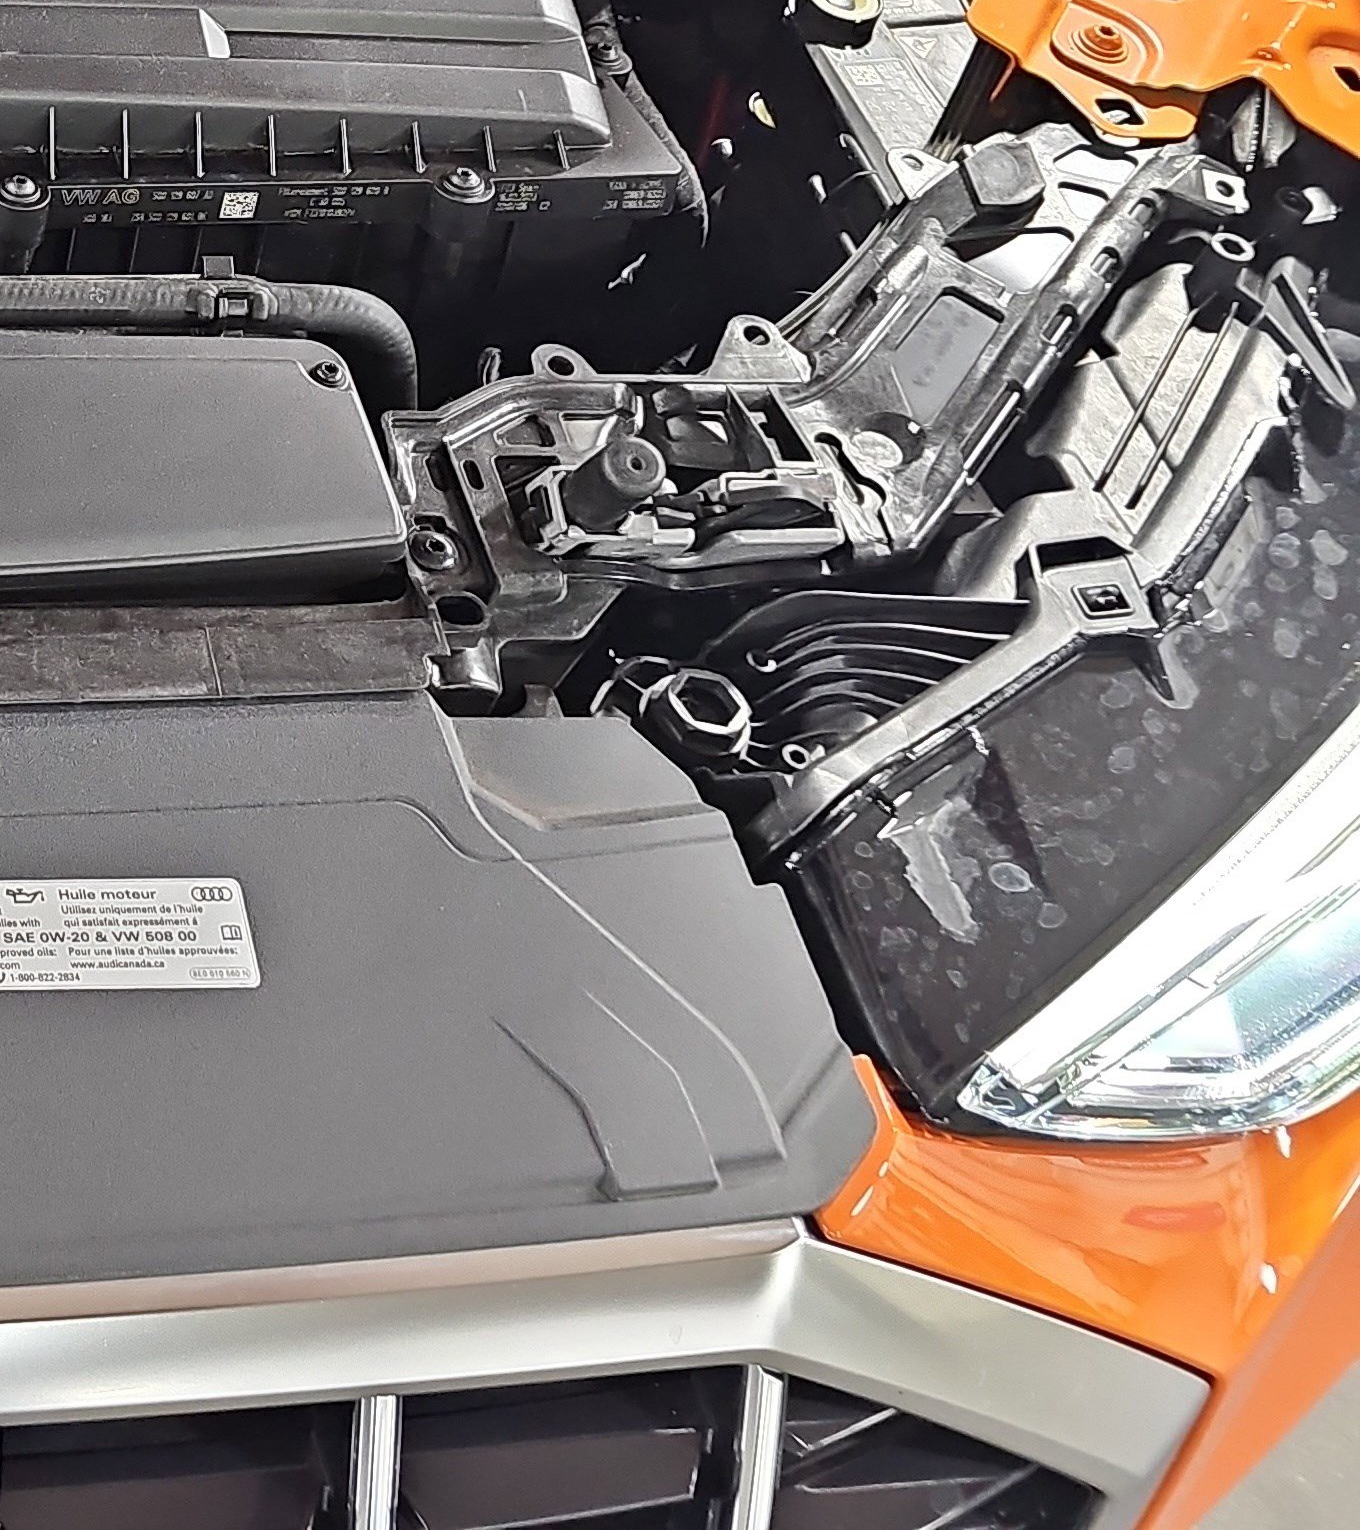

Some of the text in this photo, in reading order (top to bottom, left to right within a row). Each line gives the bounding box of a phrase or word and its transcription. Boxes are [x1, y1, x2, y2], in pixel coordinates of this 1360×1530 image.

[61, 188, 140, 206] VW AG
[58, 888, 156, 900] Huile moteur
[61, 905, 97, 914] Utilisez
[99, 905, 158, 916] uniquement
[160, 904, 172, 914] de
[20, 918, 40, 927] with
[64, 918, 79, 928] qui
[82, 918, 119, 926] satisfait
[4, 930, 196, 943] SAE 0W-20 & VW 508 00
[37, 947, 57, 956] oils:
[68, 947, 92, 956] Pour
[115, 947, 135, 956] liste
[70, 960, 165, 969] www.audicanada.ca
[10, 973, 80, 982] 1-800-822-2834
